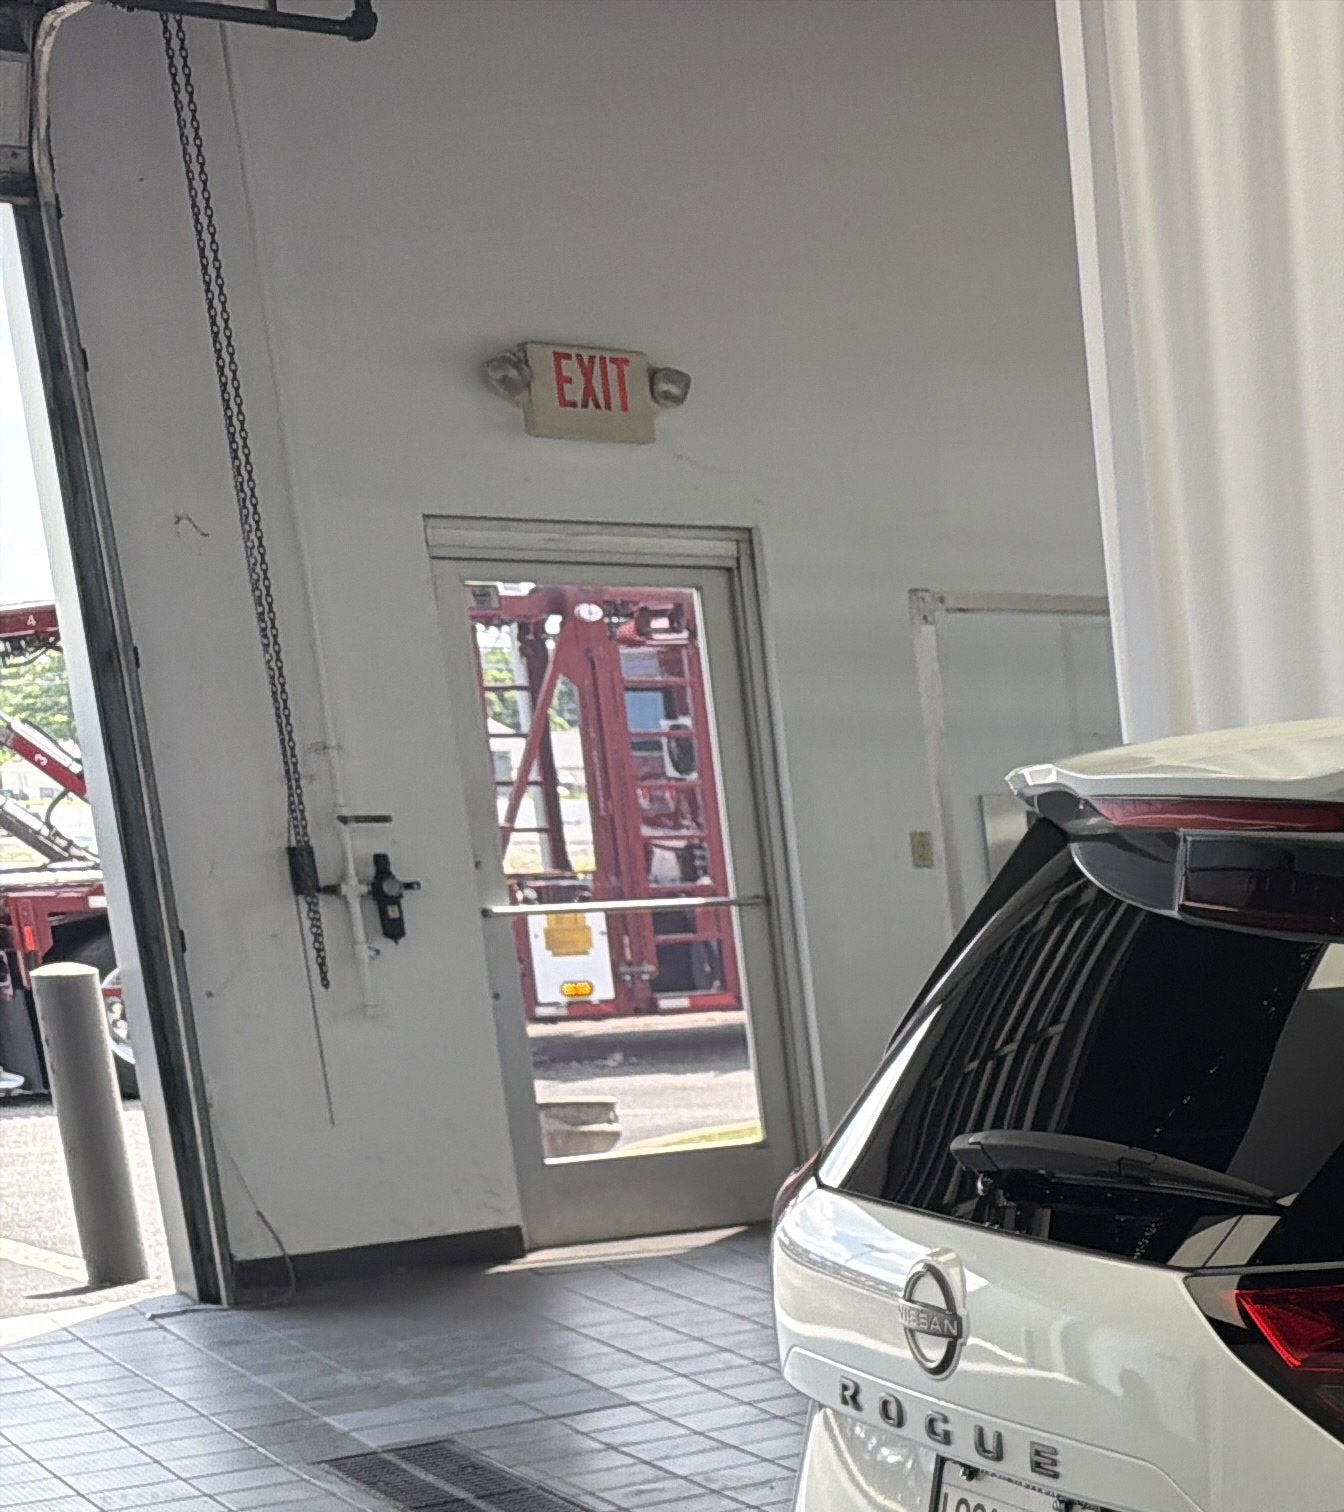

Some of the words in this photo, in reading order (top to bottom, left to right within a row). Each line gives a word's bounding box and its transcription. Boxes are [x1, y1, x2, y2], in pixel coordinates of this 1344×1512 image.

[553, 351, 630, 413] EXIT
[26, 614, 36, 627] 4
[34, 753, 48, 767] 3
[899, 1304, 958, 1336] NISSAN
[839, 1374, 1061, 1480] ROGUE
